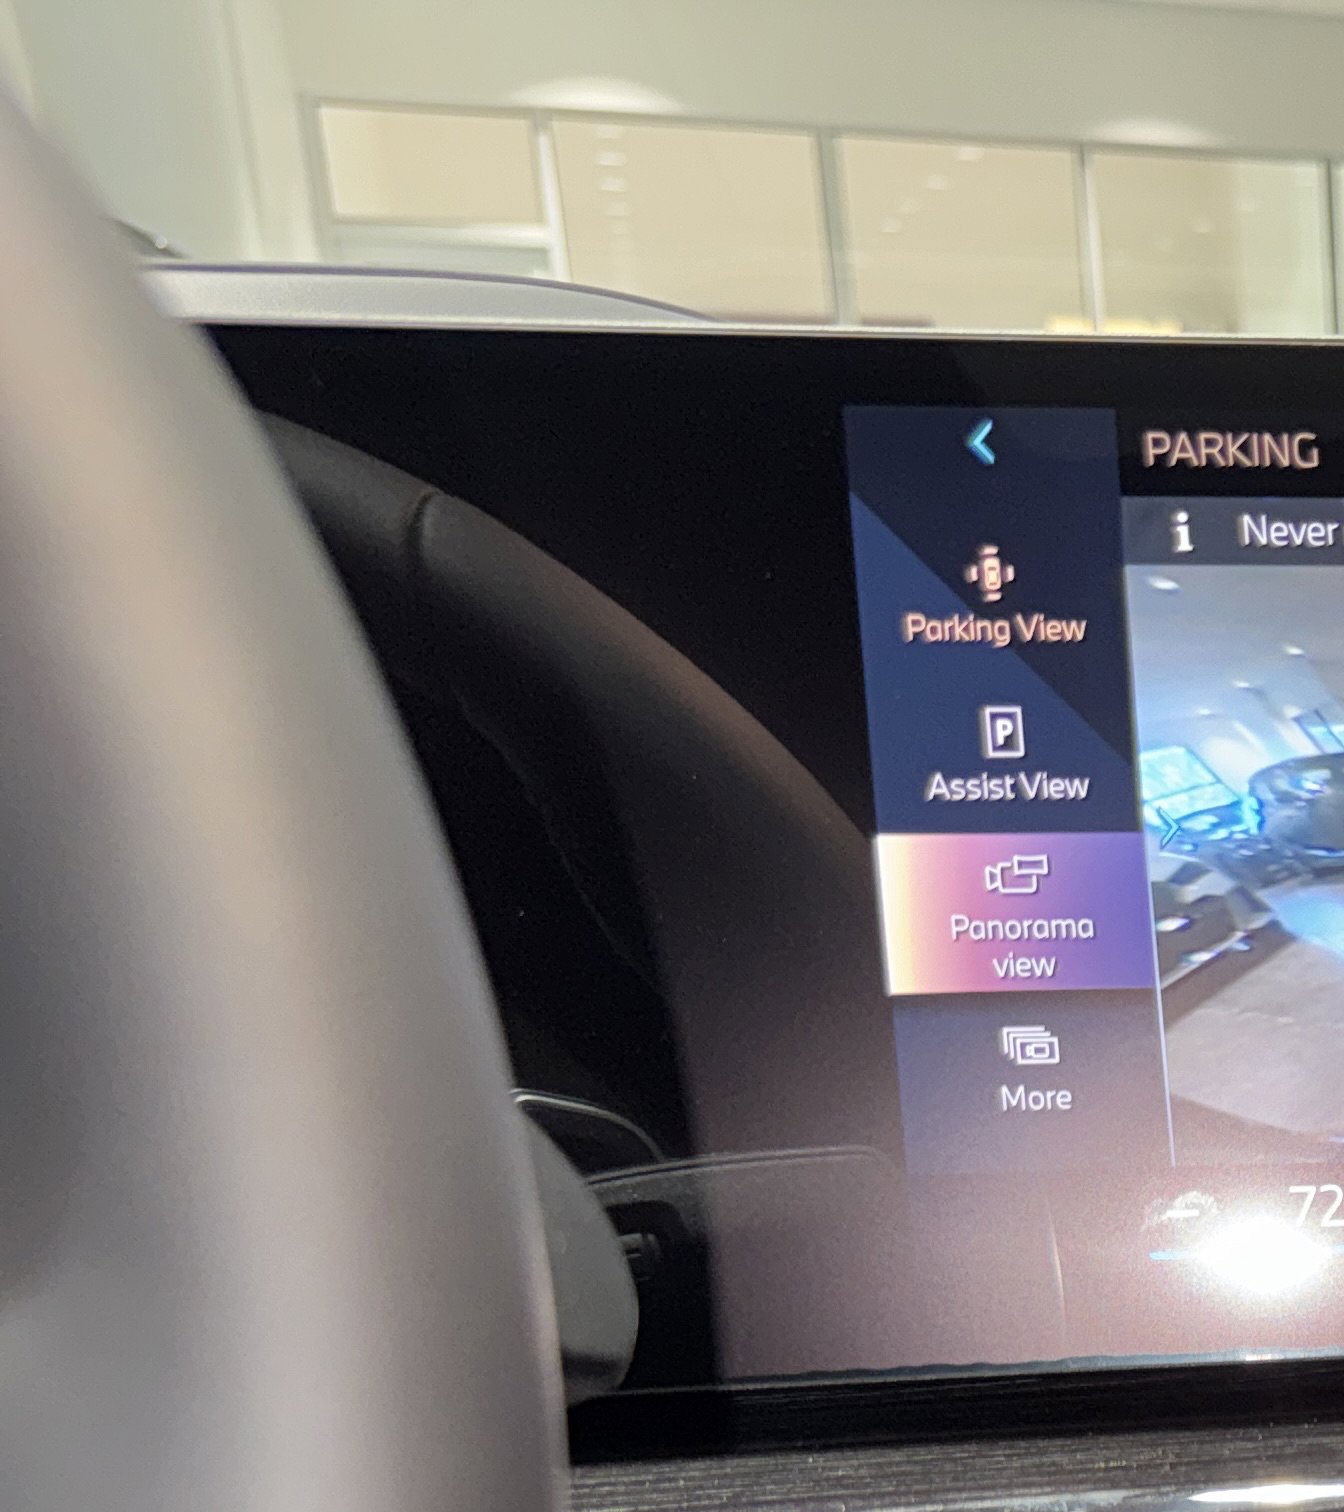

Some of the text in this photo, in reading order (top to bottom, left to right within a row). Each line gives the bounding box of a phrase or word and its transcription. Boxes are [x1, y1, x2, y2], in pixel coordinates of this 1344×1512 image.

[1142, 430, 1321, 470] PARKING
[1240, 513, 1339, 548] Never
[904, 612, 1087, 648] Parking View
[926, 772, 1091, 802] Assist View
[949, 913, 1096, 942] Panorama
[991, 952, 1058, 979] view
[1000, 1084, 1073, 1112] More
